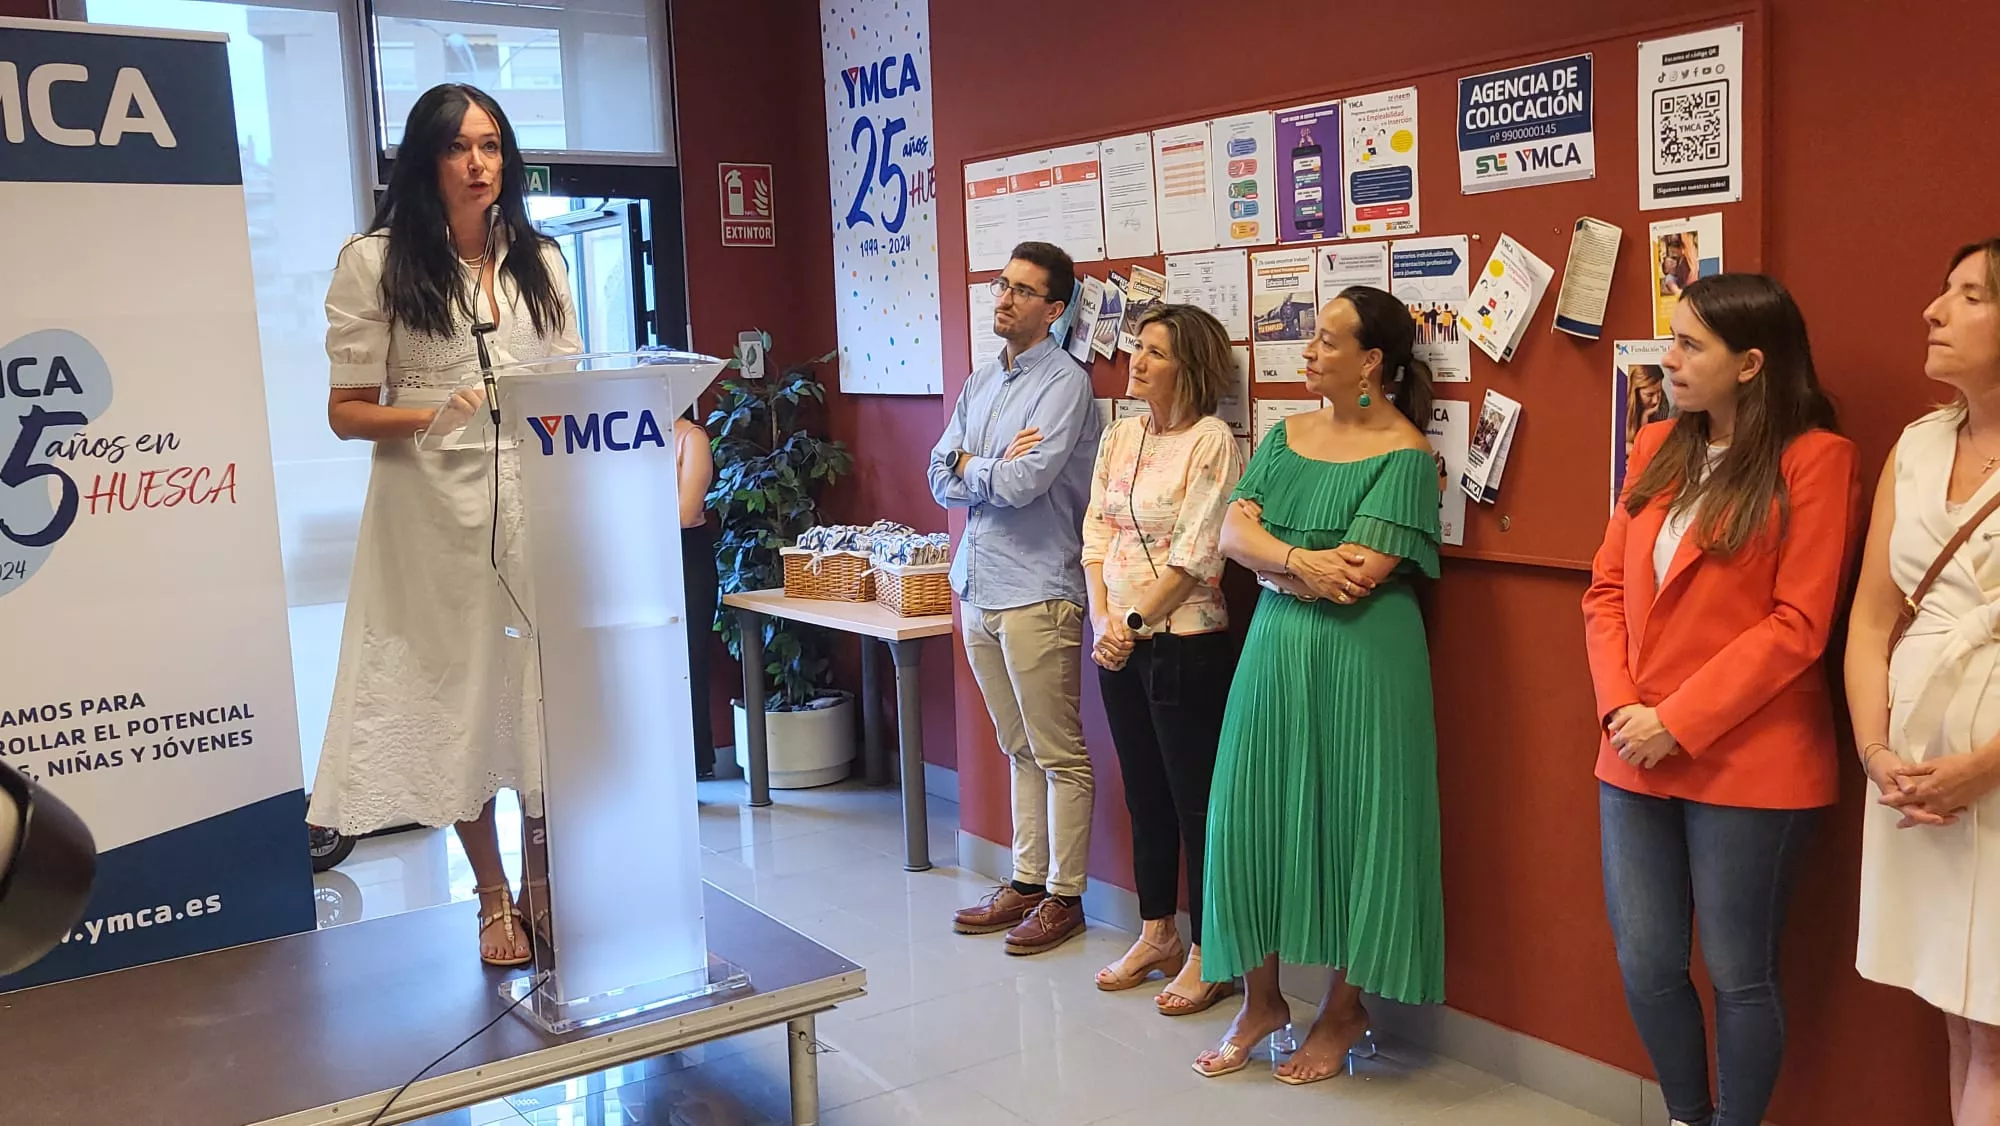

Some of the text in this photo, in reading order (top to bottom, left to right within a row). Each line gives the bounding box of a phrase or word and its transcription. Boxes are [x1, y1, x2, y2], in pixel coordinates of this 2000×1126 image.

[841, 53, 921, 109] YMCA
[1470, 66, 1578, 106] AGENCIA DE
[1366, 110, 1405, 122] Empleabilidad
[1466, 90, 1583, 130] COLOCACIÓN
[1501, 124, 1557, 141] 9900000145
[1679, 123, 1702, 134] YMCA
[903, 135, 929, 158] años
[1515, 142, 1581, 172] YMCA
[846, 115, 907, 234] 25
[725, 225, 771, 240] EXTINTOR
[860, 239, 879, 258] 1999
[889, 234, 911, 255] 2024
[0, 356, 83, 398] CA
[1431, 408, 1449, 422] CA
[45, 432, 180, 463] años en
[526, 410, 665, 456] YMCA
[84, 463, 236, 515] HUESCA
[80, 692, 146, 717] PARA
[94, 723, 121, 743] EL
[127, 703, 255, 737] POTENCIAL
[47, 749, 124, 777] NIÑAS
[130, 746, 147, 764] Y
[151, 730, 254, 761] JÓVENES
